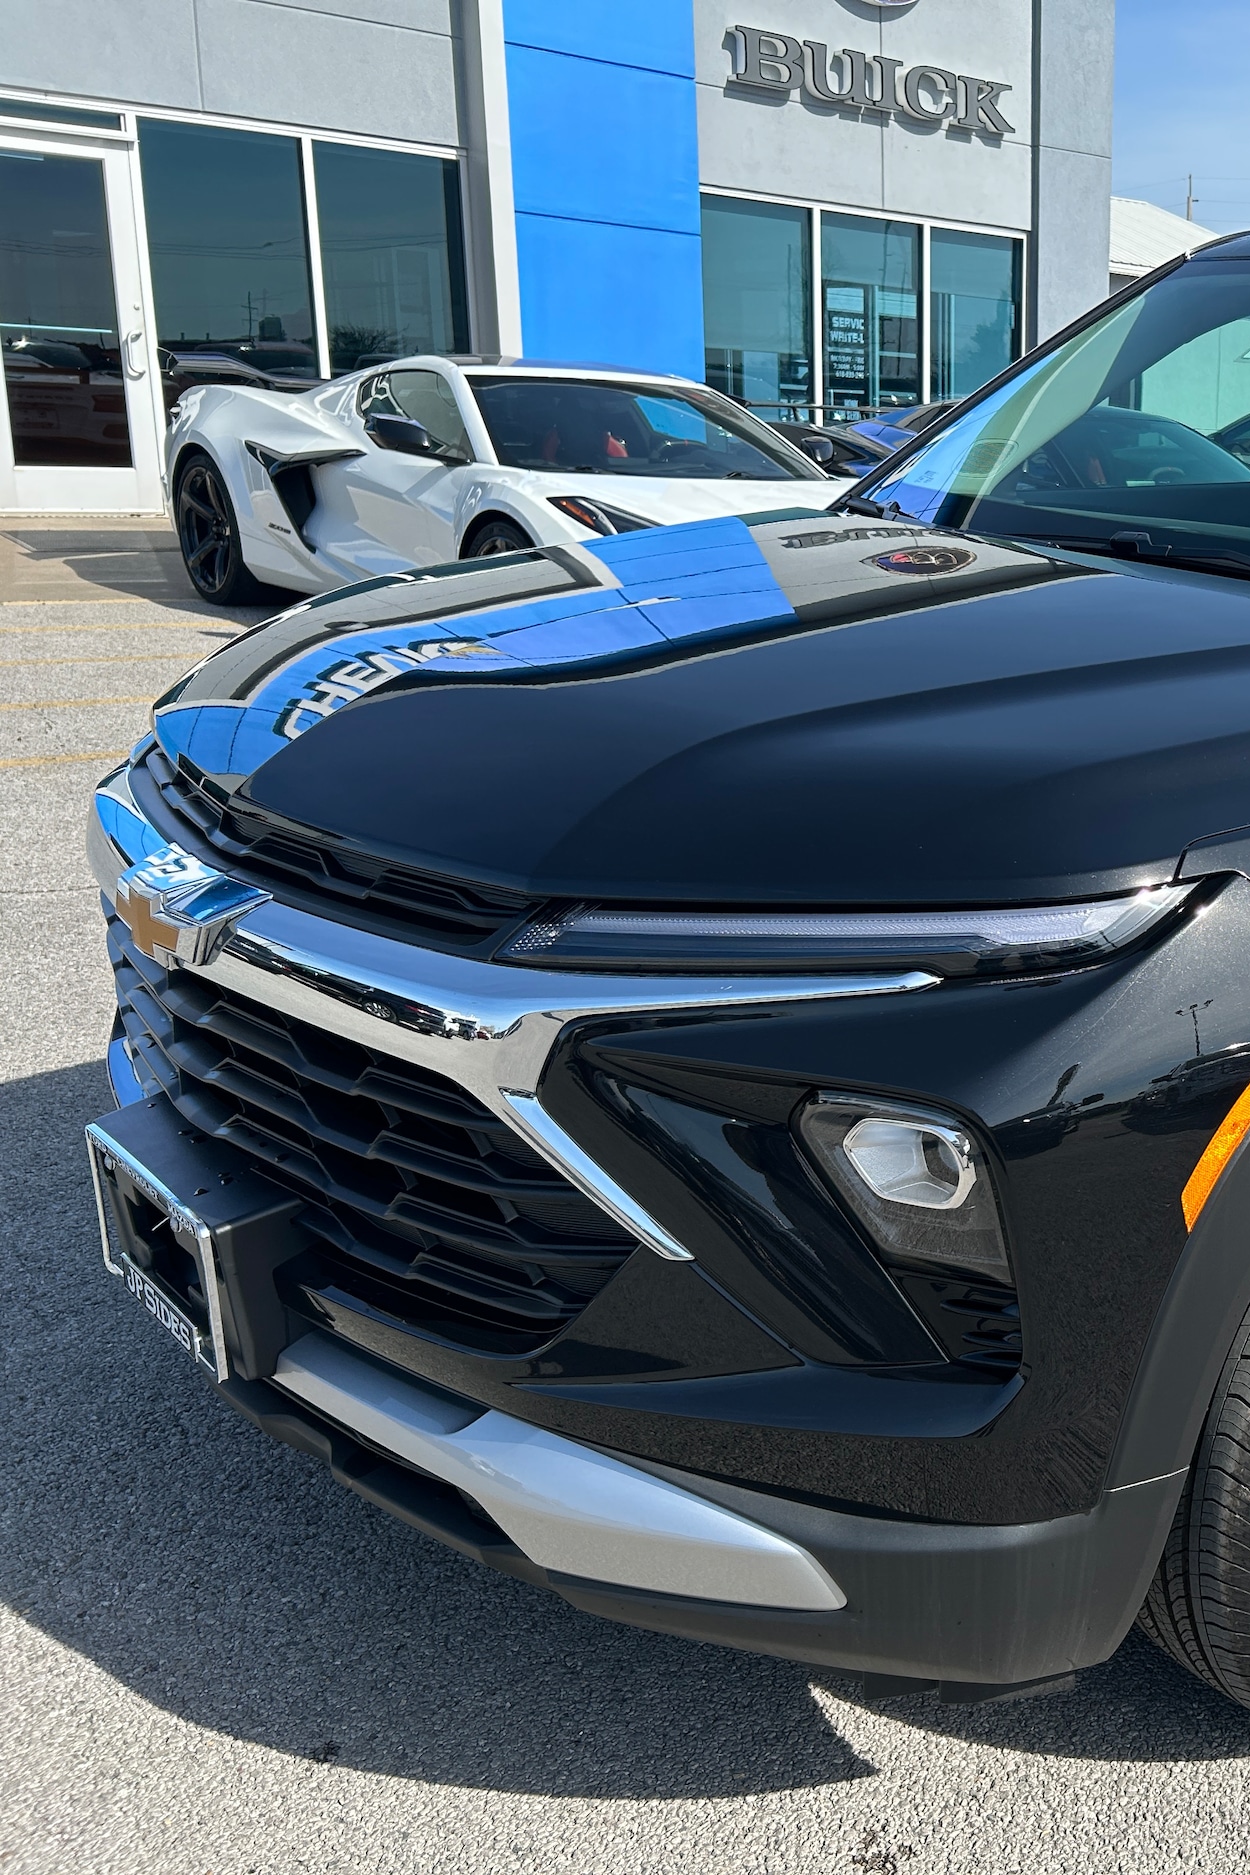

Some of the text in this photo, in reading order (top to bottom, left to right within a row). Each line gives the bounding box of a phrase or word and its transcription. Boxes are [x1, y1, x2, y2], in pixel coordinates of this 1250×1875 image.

[722, 25, 1016, 134] BUICK
[832, 316, 864, 329] SERVIC
[127, 1266, 191, 1351] JP SIDES
